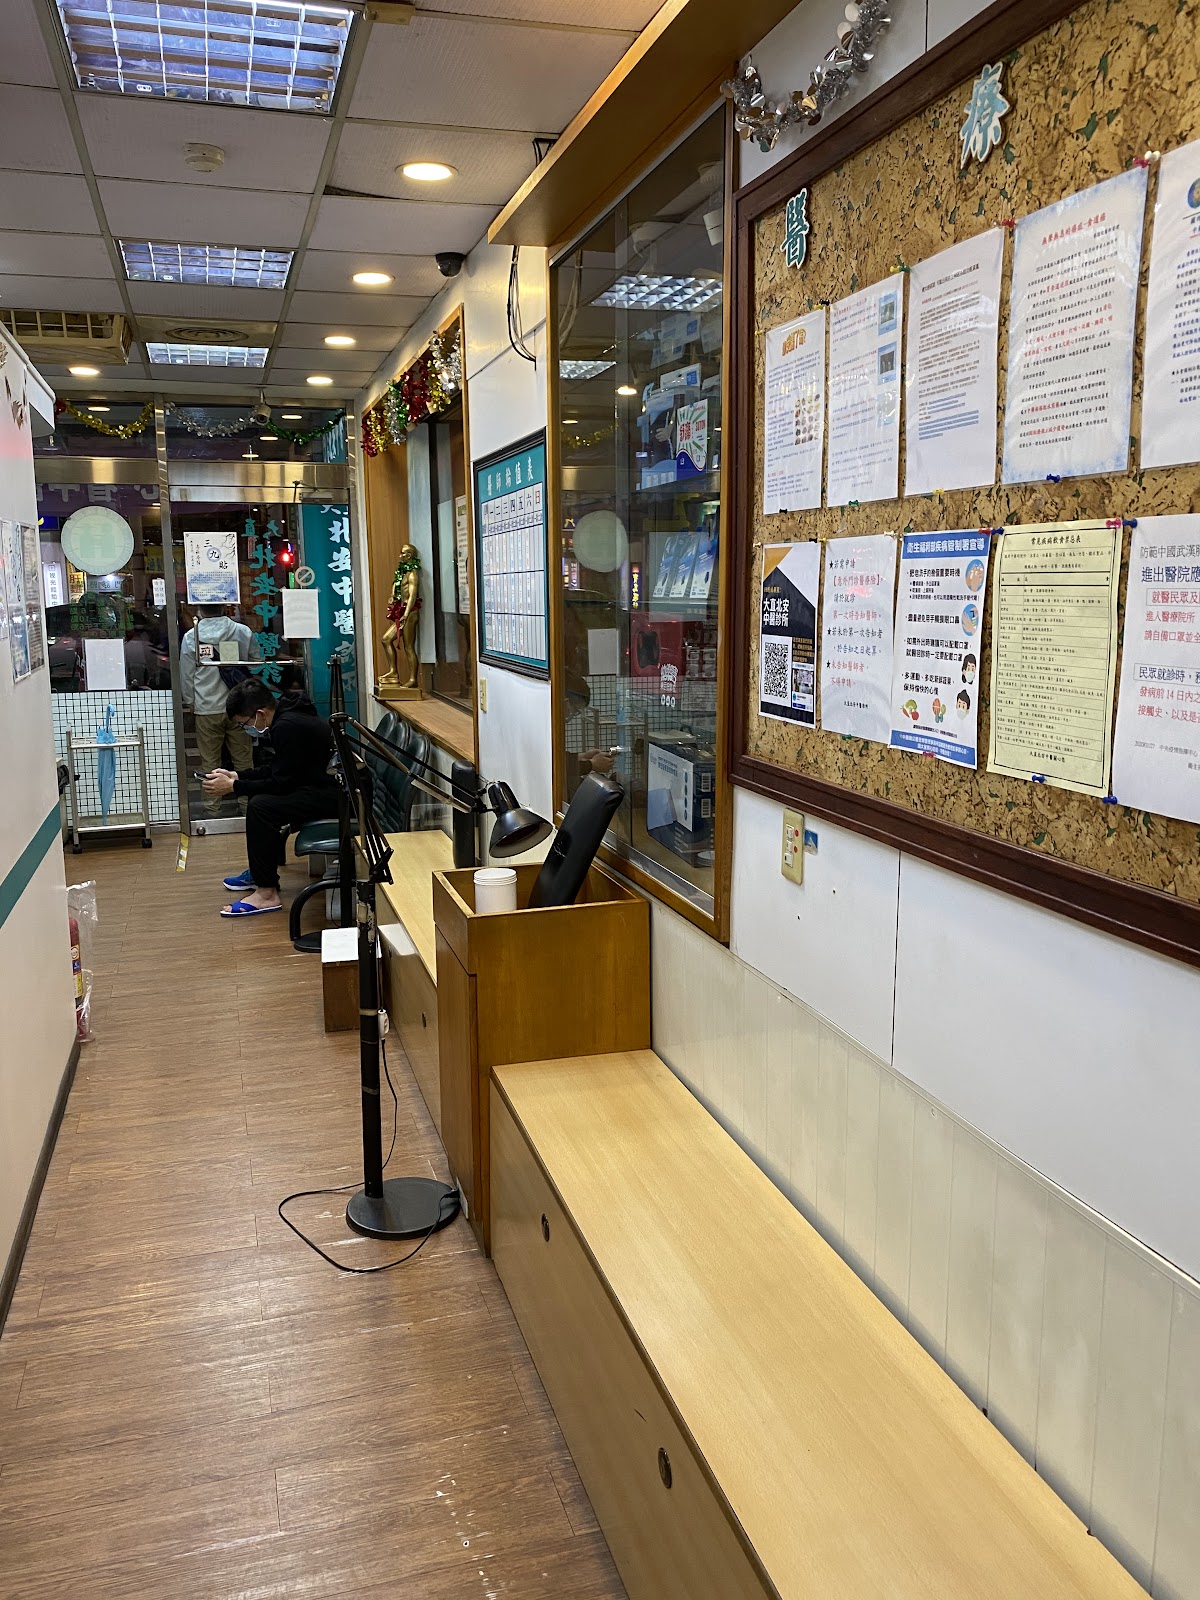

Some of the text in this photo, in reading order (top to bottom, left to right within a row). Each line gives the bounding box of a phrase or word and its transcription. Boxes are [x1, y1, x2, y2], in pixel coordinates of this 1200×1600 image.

[782, 61, 1010, 269] 醫 療
[763, 598, 790, 613] 大直北安
[1151, 591, 1200, 604] 就醫民眾及
[763, 611, 789, 628] 中醫診所
